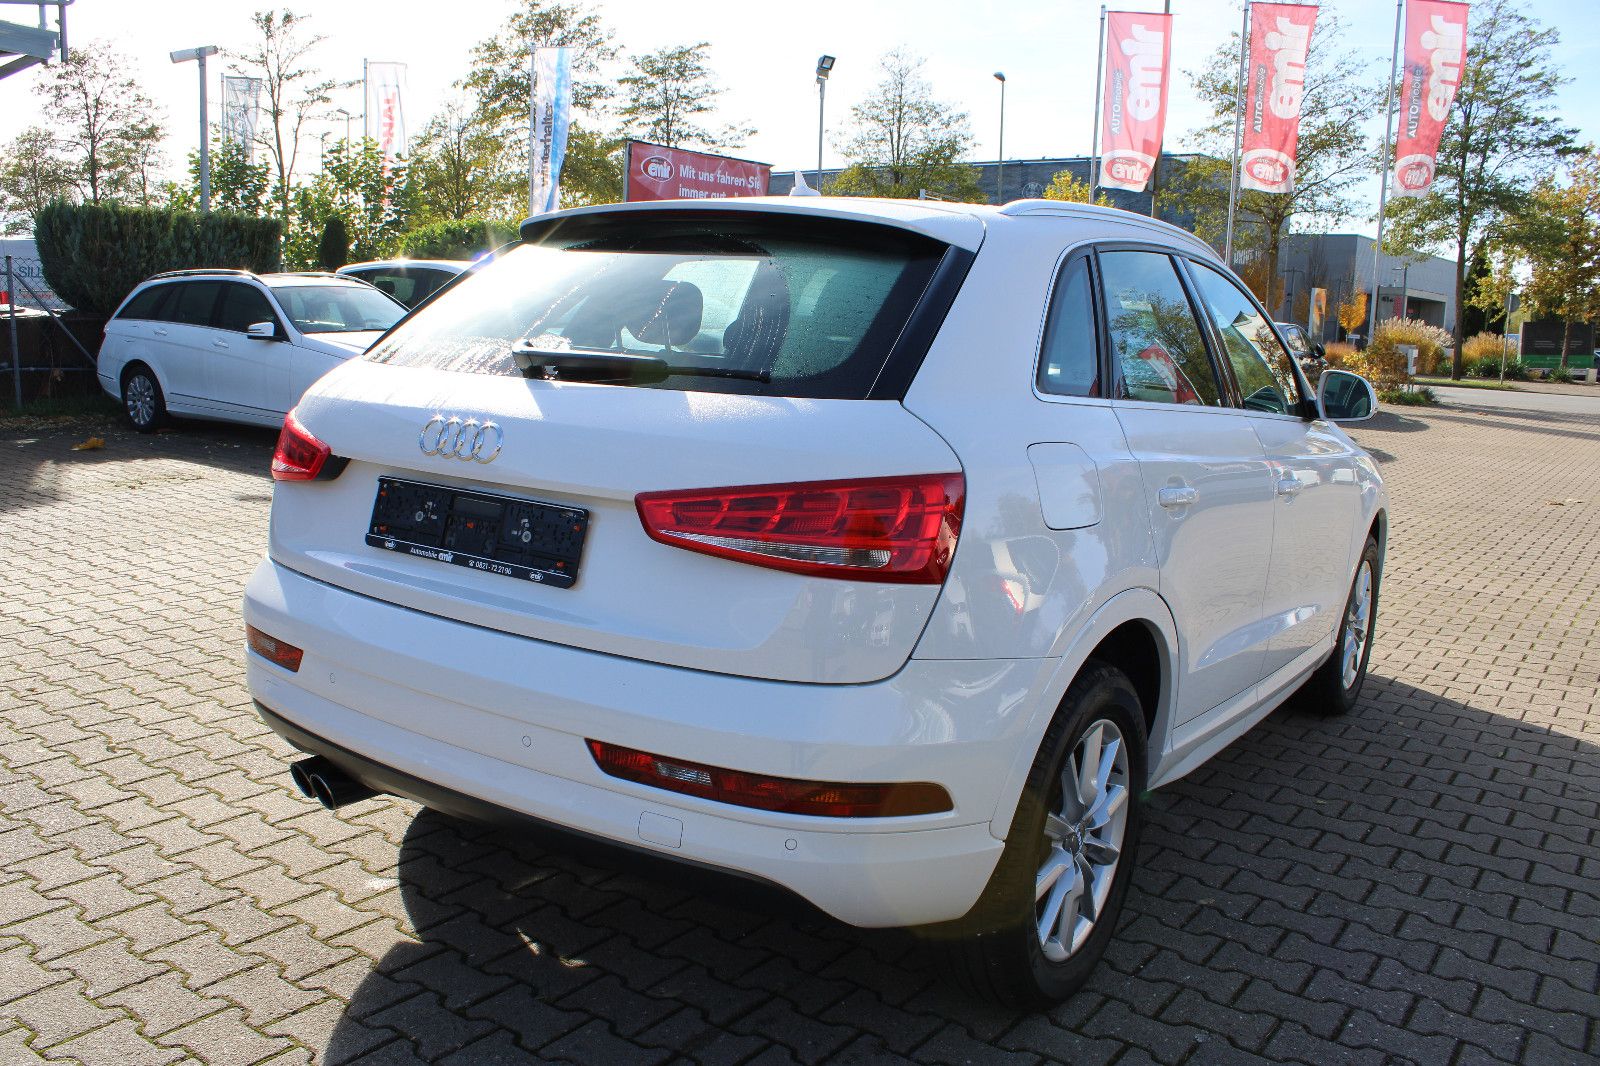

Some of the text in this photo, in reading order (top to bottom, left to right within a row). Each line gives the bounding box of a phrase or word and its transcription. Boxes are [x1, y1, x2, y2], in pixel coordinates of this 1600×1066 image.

[1121, 24, 1164, 121] emir
[1264, 16, 1309, 119] emir
[1420, 15, 1463, 122] emir
[679, 184, 708, 198] immer
[680, 164, 696, 180] Mit
[698, 171, 714, 182] uns
[717, 170, 746, 187] fahren
[1112, 162, 1147, 181] emir
